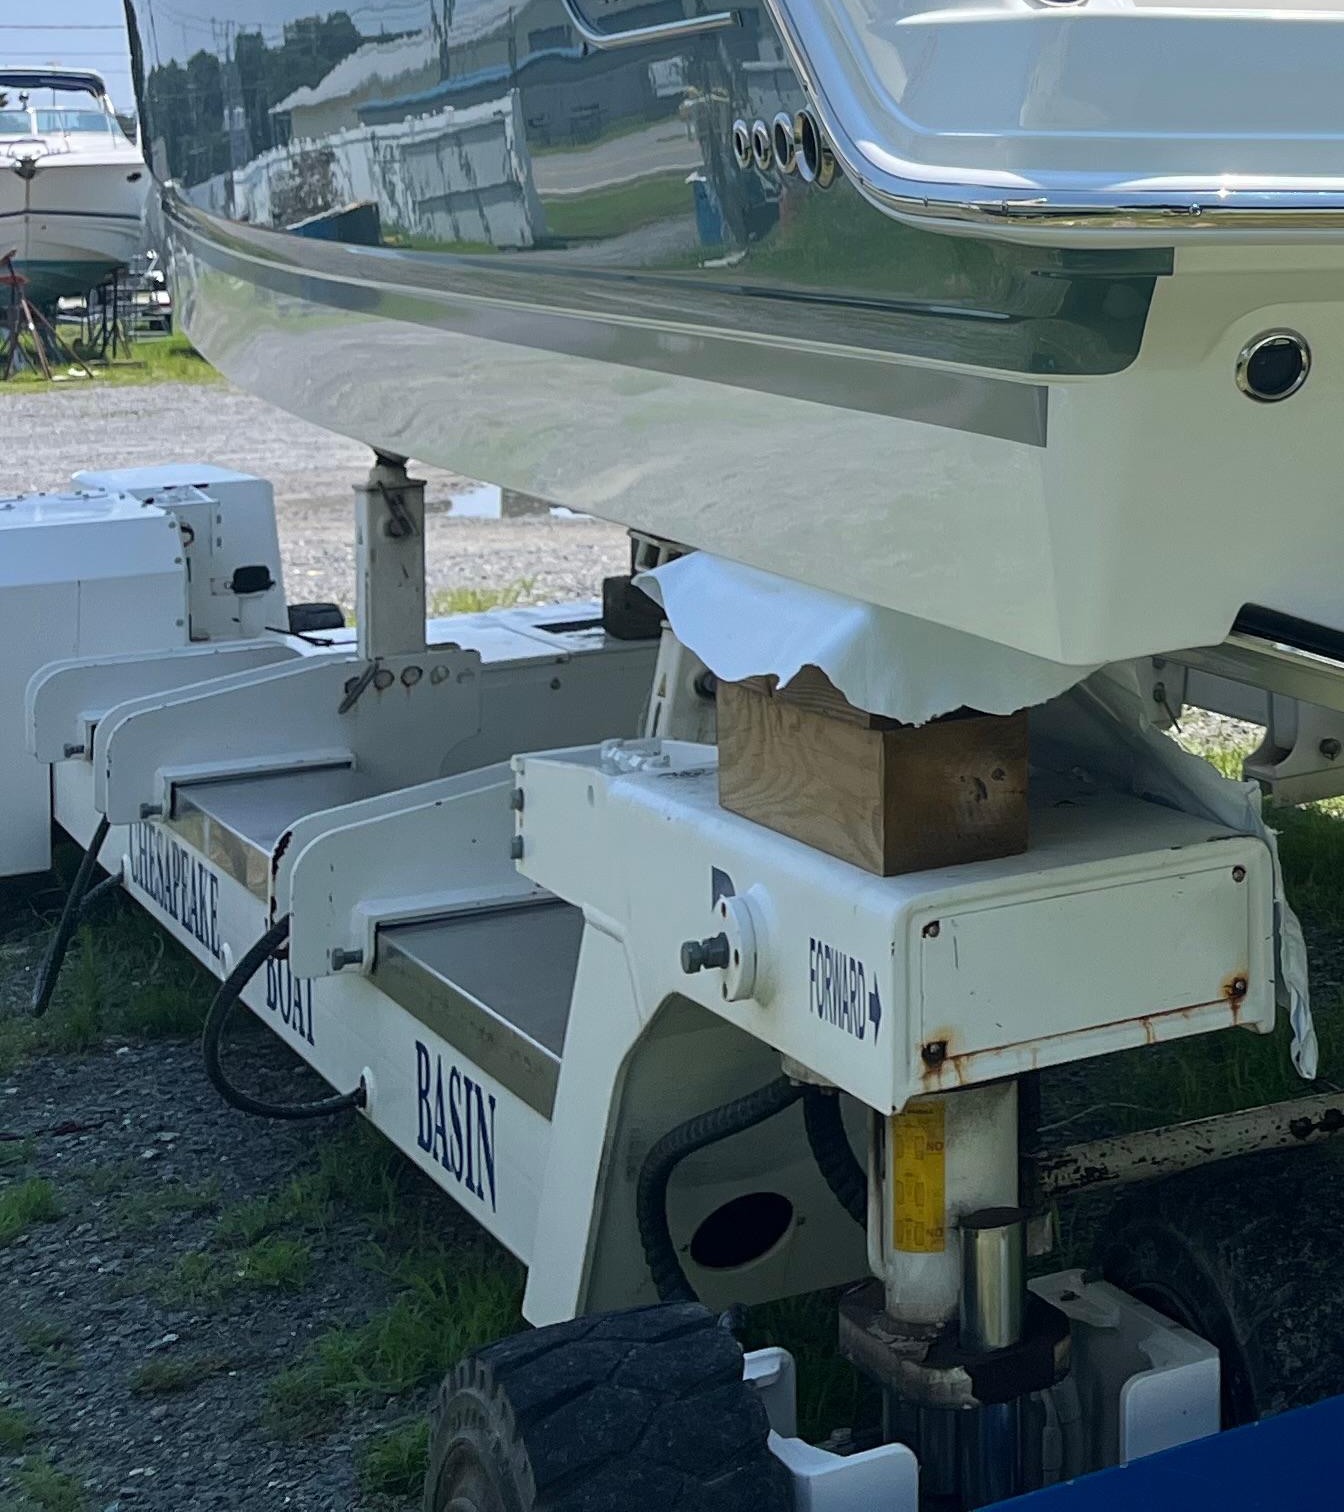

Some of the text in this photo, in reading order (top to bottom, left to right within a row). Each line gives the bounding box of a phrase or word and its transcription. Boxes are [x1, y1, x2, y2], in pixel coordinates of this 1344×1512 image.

[128, 823, 220, 960] CHESAPEAKE
[415, 1040, 497, 1213] BASIN
[809, 937, 866, 1040] FORWARD
